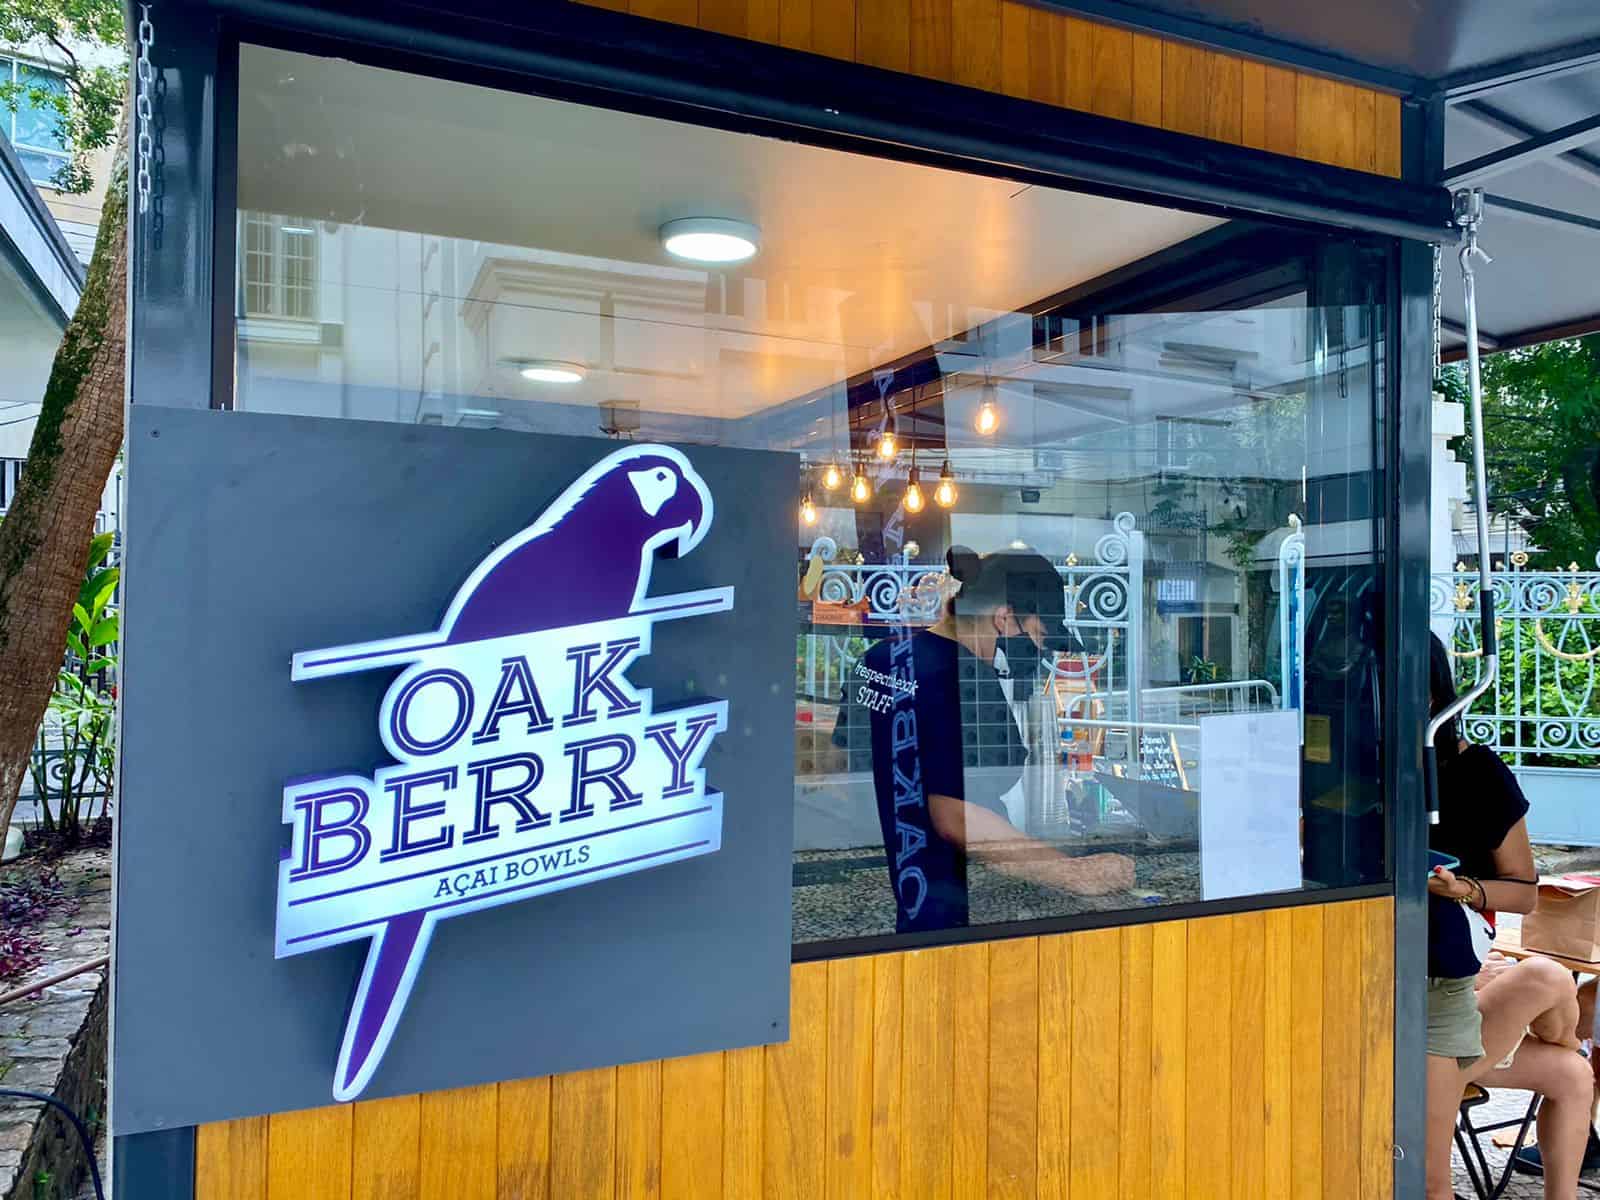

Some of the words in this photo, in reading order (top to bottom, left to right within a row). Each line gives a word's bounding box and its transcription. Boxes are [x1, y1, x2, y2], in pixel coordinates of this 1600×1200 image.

[390, 637, 641, 756] OAK
[856, 686, 894, 713] STAFF
[289, 713, 718, 883] BERRY
[433, 865, 499, 898] AÇAI
[504, 845, 591, 884] BOWLS
